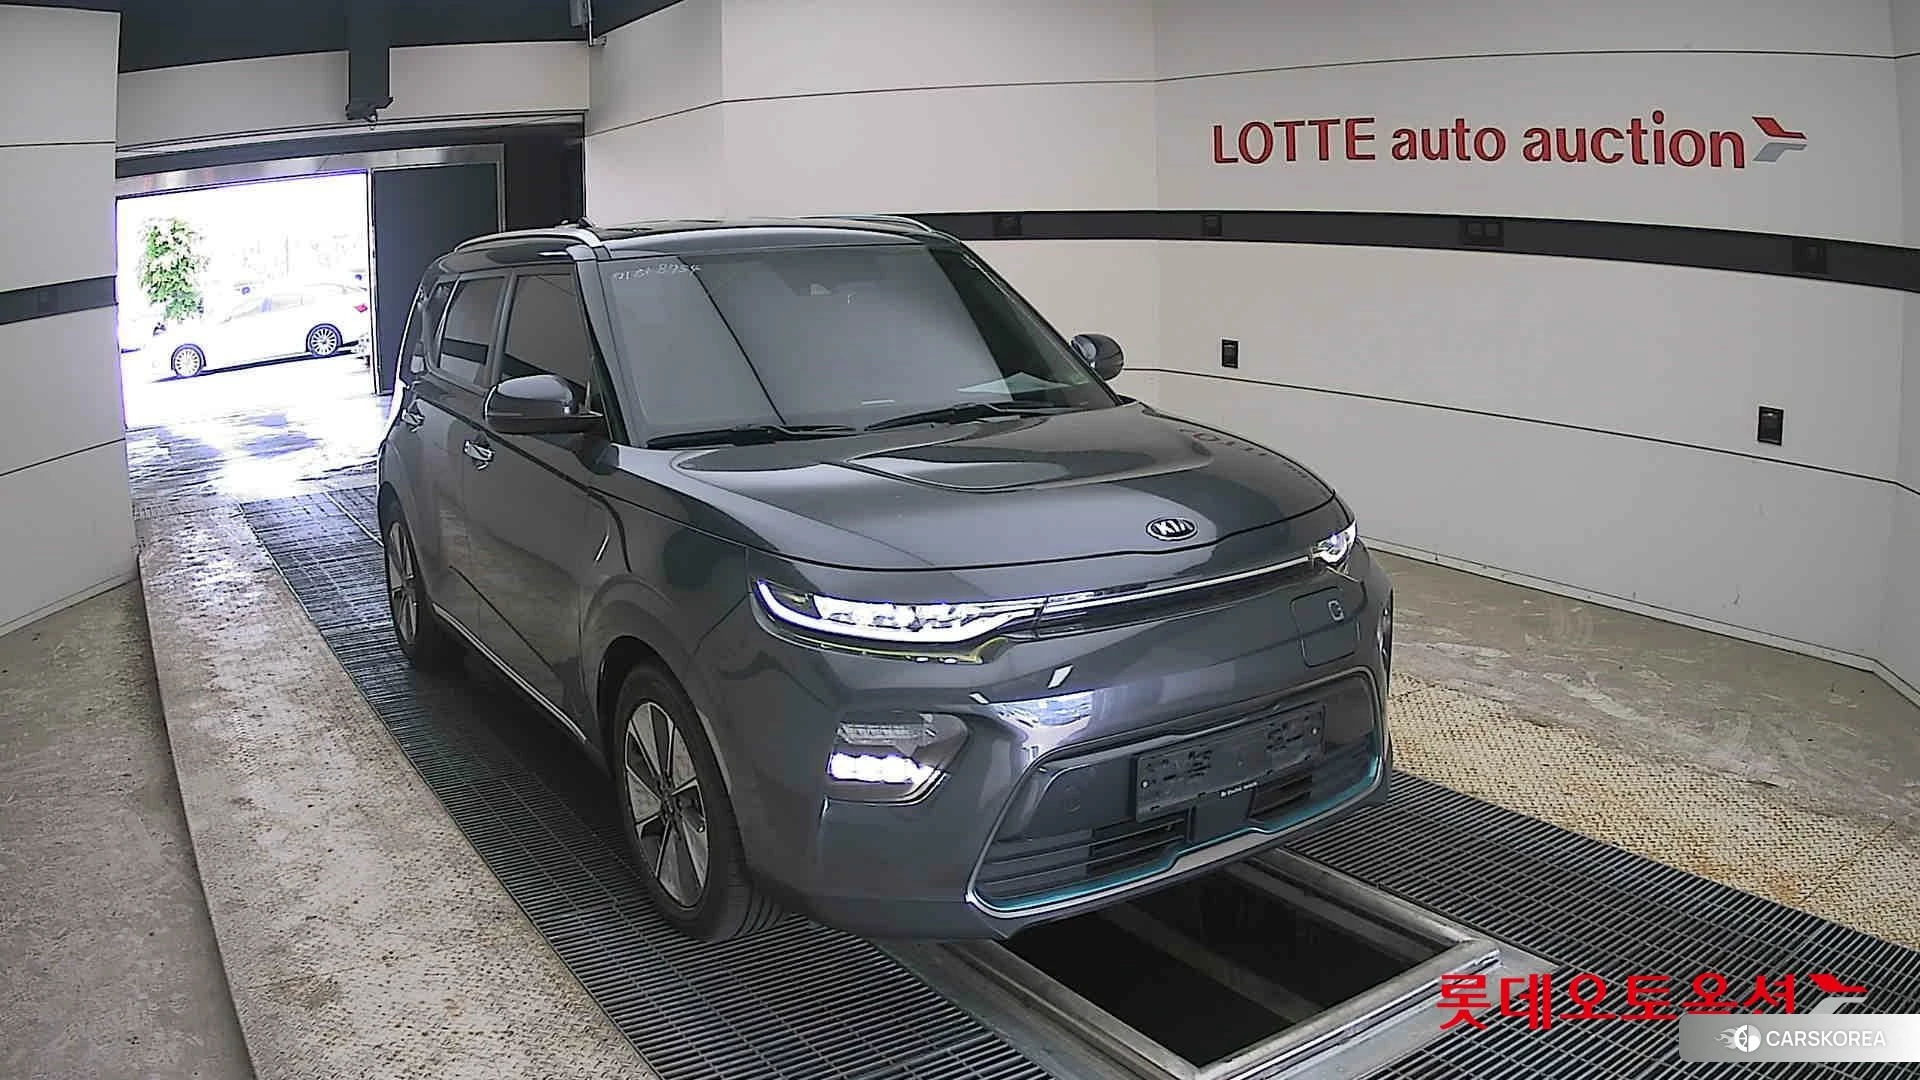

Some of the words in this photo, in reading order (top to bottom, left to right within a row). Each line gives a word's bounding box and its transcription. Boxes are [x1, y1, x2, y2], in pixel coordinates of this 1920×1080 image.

[1212, 116, 1376, 165] LOTTE
[1391, 117, 1506, 162] auto
[1522, 110, 1746, 169] auction
[1151, 518, 1195, 537] KIA
